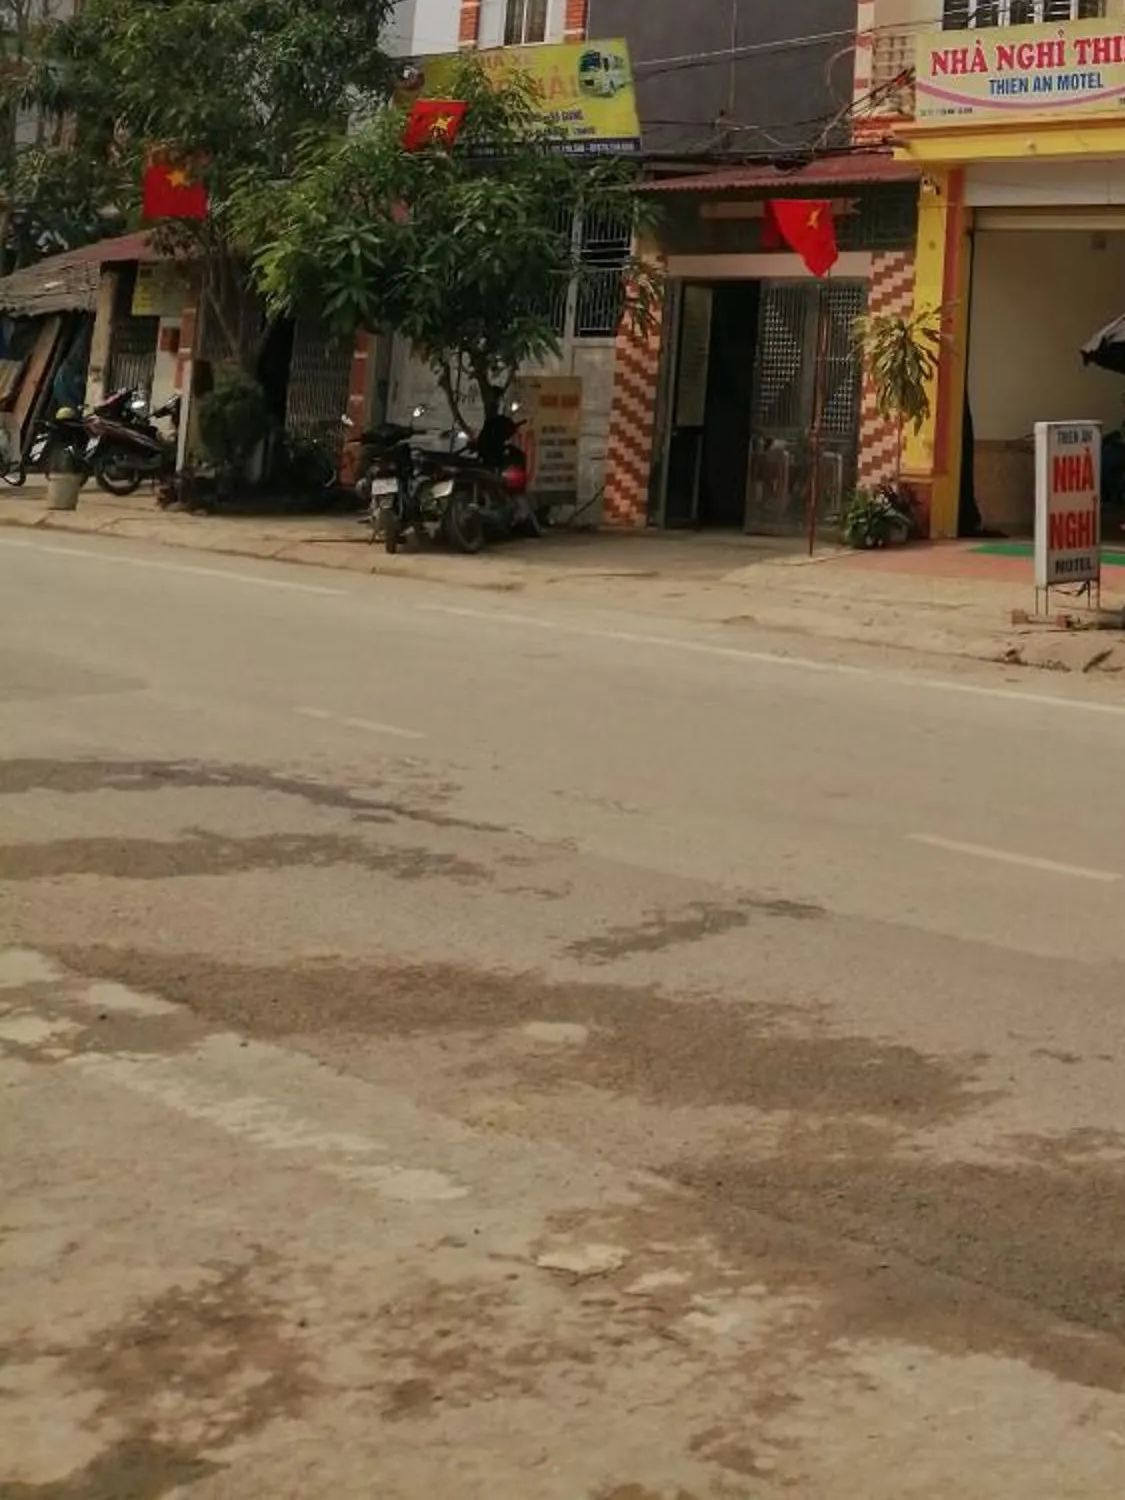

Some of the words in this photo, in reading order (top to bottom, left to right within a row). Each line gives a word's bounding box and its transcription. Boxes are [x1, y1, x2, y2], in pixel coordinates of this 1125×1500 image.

[930, 39, 988, 76] NHÀ
[995, 29, 1066, 71] NGHỈ
[988, 77, 1029, 96] THIEN
[1033, 75, 1053, 93] AN
[1057, 72, 1103, 91] MOTEL
[1053, 446, 1095, 493] NHÀ
[1049, 495, 1098, 550] NGHỈ
